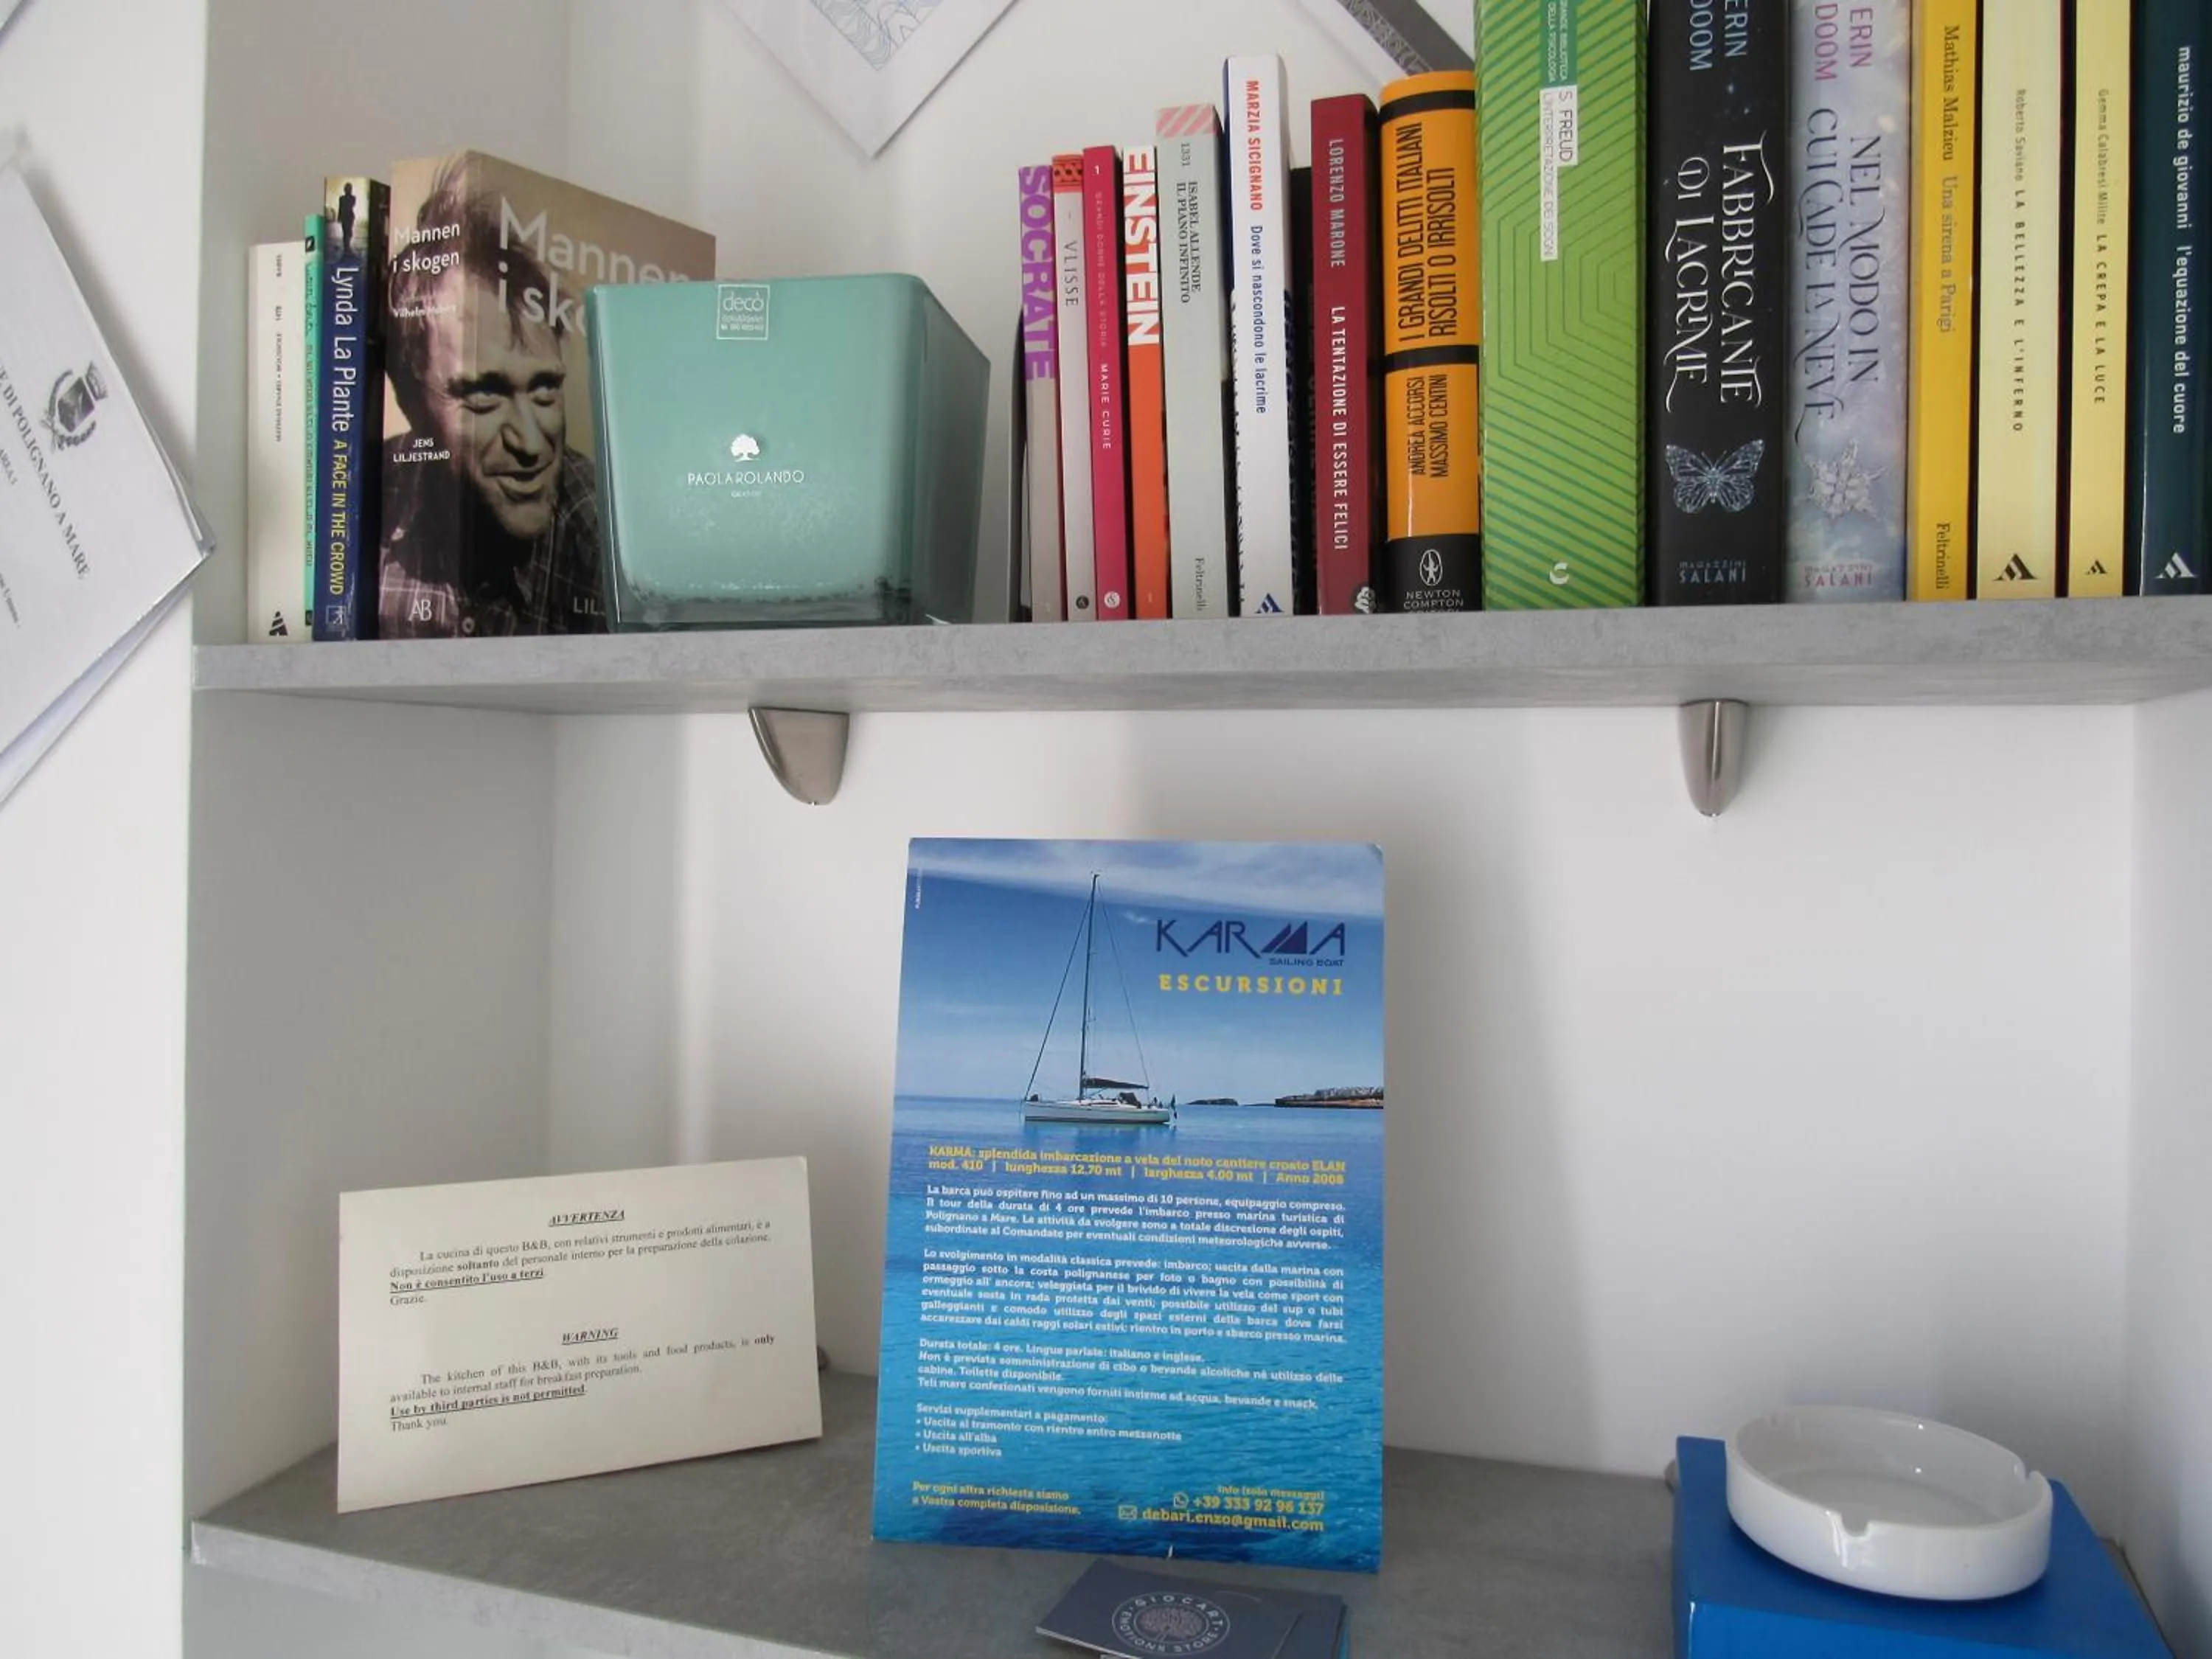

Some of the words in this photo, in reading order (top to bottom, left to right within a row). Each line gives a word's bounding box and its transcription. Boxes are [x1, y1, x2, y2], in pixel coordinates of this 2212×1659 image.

[1548, 3, 1556, 29] DELLA
[1850, 8, 1874, 67] ERIN
[1548, 33, 1556, 83] PSICOLOGIA
[1559, 32, 1568, 80] BIBLIOTECA
[1814, 4, 1837, 80] DOOM
[1941, 25, 1958, 91] Mathias
[1245, 80, 1261, 132] MARZIA
[1559, 91, 1573, 102] S.
[2177, 47, 2193, 123] maurizio
[1941, 97, 1958, 161] Malzieu
[2015, 89, 2026, 133] Roberto
[2097, 89, 2108, 130] Gemma
[1397, 122, 1422, 190] ITALIANI
[1543, 91, 1554, 193] L'INTERPRETAZIONE
[1559, 110, 1573, 161] FREUD
[1806, 109, 1837, 171] CUI
[2176, 129, 2193, 150] de
[1094, 165, 1100, 174] 1
[1248, 137, 1264, 210] SICIGNANO
[1329, 139, 1345, 203] LORENZO
[1677, 158, 1710, 198] DI
[1848, 136, 1882, 205] NEL
[2014, 136, 2025, 181] Saviano
[2096, 134, 2109, 188] Calabresi
[1177, 181, 1187, 195] IL
[1188, 181, 1199, 227] ISABEL
[1429, 167, 1456, 250] IRRISOLTI
[1543, 198, 1554, 220] DEI
[1941, 176, 1957, 210] Una
[2014, 189, 2025, 209] LA
[2096, 192, 2108, 225] Milite
[2173, 156, 2194, 229] giovanni
[394, 223, 460, 244] Mannen
[1177, 198, 1189, 239] PIANO
[1251, 226, 1265, 255] Dove
[1330, 209, 1346, 268] MARONE
[1398, 197, 1425, 258] DELITTI
[1543, 223, 1554, 257] SOGNI
[1800, 181, 1843, 267] CADE
[1941, 214, 1956, 264] sirena
[393, 255, 397, 272] i
[403, 251, 459, 274] skogen
[1124, 147, 1159, 345] EINSTEIN
[1190, 231, 1201, 292] ALLENDE
[1252, 260, 1265, 270] si
[1429, 257, 1456, 268] O
[2014, 222, 2025, 307] BELLEZZA
[2095, 234, 2107, 252] LA
[498, 261, 507, 313] i
[1019, 165, 1056, 381] SOCRATE
[1179, 243, 1192, 303] INFINITO
[1719, 131, 1774, 407] FABBRICANTE
[1840, 208, 1885, 335] MODO
[1941, 271, 1952, 279] a
[2095, 262, 2107, 312] CREPA
[331, 266, 359, 325] Lynda
[1252, 274, 1267, 347] nascondono
[1332, 307, 1345, 324] LA
[1398, 266, 1424, 331] GRANDI
[1429, 274, 1456, 336] RISOLTI
[1665, 218, 1715, 412] LACRIME
[1805, 283, 1834, 313] LA
[1937, 284, 1956, 332] Parigi
[2170, 246, 2192, 344] l'equazione
[334, 336, 355, 359] La
[2095, 321, 2107, 330] E
[2095, 338, 2106, 355] LA
[1254, 352, 1267, 363] le
[1332, 330, 1346, 417] TENTAZIONE
[1848, 349, 1879, 384] IN
[2174, 352, 2190, 378] del
[332, 367, 355, 431] Plante
[1100, 363, 1112, 404] MARIE
[1255, 368, 1269, 414] lacrime
[1408, 378, 1425, 425] ACCORSI
[1430, 375, 1447, 415] CENTINI
[1795, 320, 1844, 445] NEVE
[2013, 338, 2024, 433] L'INFERNO
[2094, 365, 2106, 405] LUCE
[1102, 410, 1112, 449] CURIE
[1333, 422, 1346, 437] DI
[2173, 383, 2188, 433] cuore
[333, 439, 346, 450] A
[393, 451, 451, 462] LILJESTRAND
[412, 438, 434, 448] JENS
[1408, 430, 1425, 475] ANDREA
[1430, 422, 1447, 478] MASSIMO
[3, 384, 18, 407] DI
[12, 406, 61, 509] POLIGNANO
[57, 512, 67, 525] A
[63, 524, 90, 579] MARE
[332, 454, 347, 488] FACE
[1333, 443, 1347, 497] ESSERE
[331, 493, 346, 507] IN
[331, 512, 345, 538] THE
[1333, 503, 1348, 549] FELICI
[330, 542, 344, 594] CROWD
[1679, 568, 1747, 583] SALANI
[1935, 523, 1950, 589] Feltrinelli
[1194, 557, 1206, 611] Feltrinelli
[1406, 590, 1461, 599] NEWTON
[1804, 574, 1872, 587] SALANI
[1404, 599, 1464, 610] COMPTON
[1156, 919, 1345, 958] KARMA
[1159, 973, 1342, 995] ESCURSIONI
[928, 1161, 959, 1169] mod.
[961, 1161, 983, 1169] 410
[1006, 1164, 1067, 1175] lunghezza
[1071, 1165, 1102, 1175] 12.70
[1105, 1166, 1121, 1175] mt
[1144, 1169, 1203, 1180] larghezza
[1207, 1169, 1233, 1179] 4.00
[1237, 1171, 1253, 1180] mt
[1276, 1174, 1309, 1183] Anno
[979, 1150, 1036, 1161] splendida
[1040, 1151, 1121, 1164] imbarcazione
[1135, 1156, 1158, 1165] vela
[1162, 1156, 1180, 1165] del
[1184, 1158, 1212, 1166] noto
[1216, 1158, 1266, 1169] cantiere
[1312, 1161, 1345, 1171] ELAN
[549, 1210, 625, 1225] AVVERTENZA
[390, 1281, 412, 1291] Non
[425, 1276, 480, 1288] consentito
[483, 1272, 507, 1283] l'uso
[562, 1329, 619, 1344] WARNING
[391, 1407, 411, 1416] Use
[414, 1404, 426, 1415] by
[431, 1400, 458, 1411] third
[462, 1397, 498, 1410] parties
[513, 1391, 530, 1402] not
[1143, 1510, 1324, 1531] debari.enzo@gmail.com
[1193, 1497, 1220, 1509] +39
[1225, 1498, 1250, 1509] 333
[1255, 1499, 1272, 1511] 92
[1298, 1501, 1324, 1514] 137
